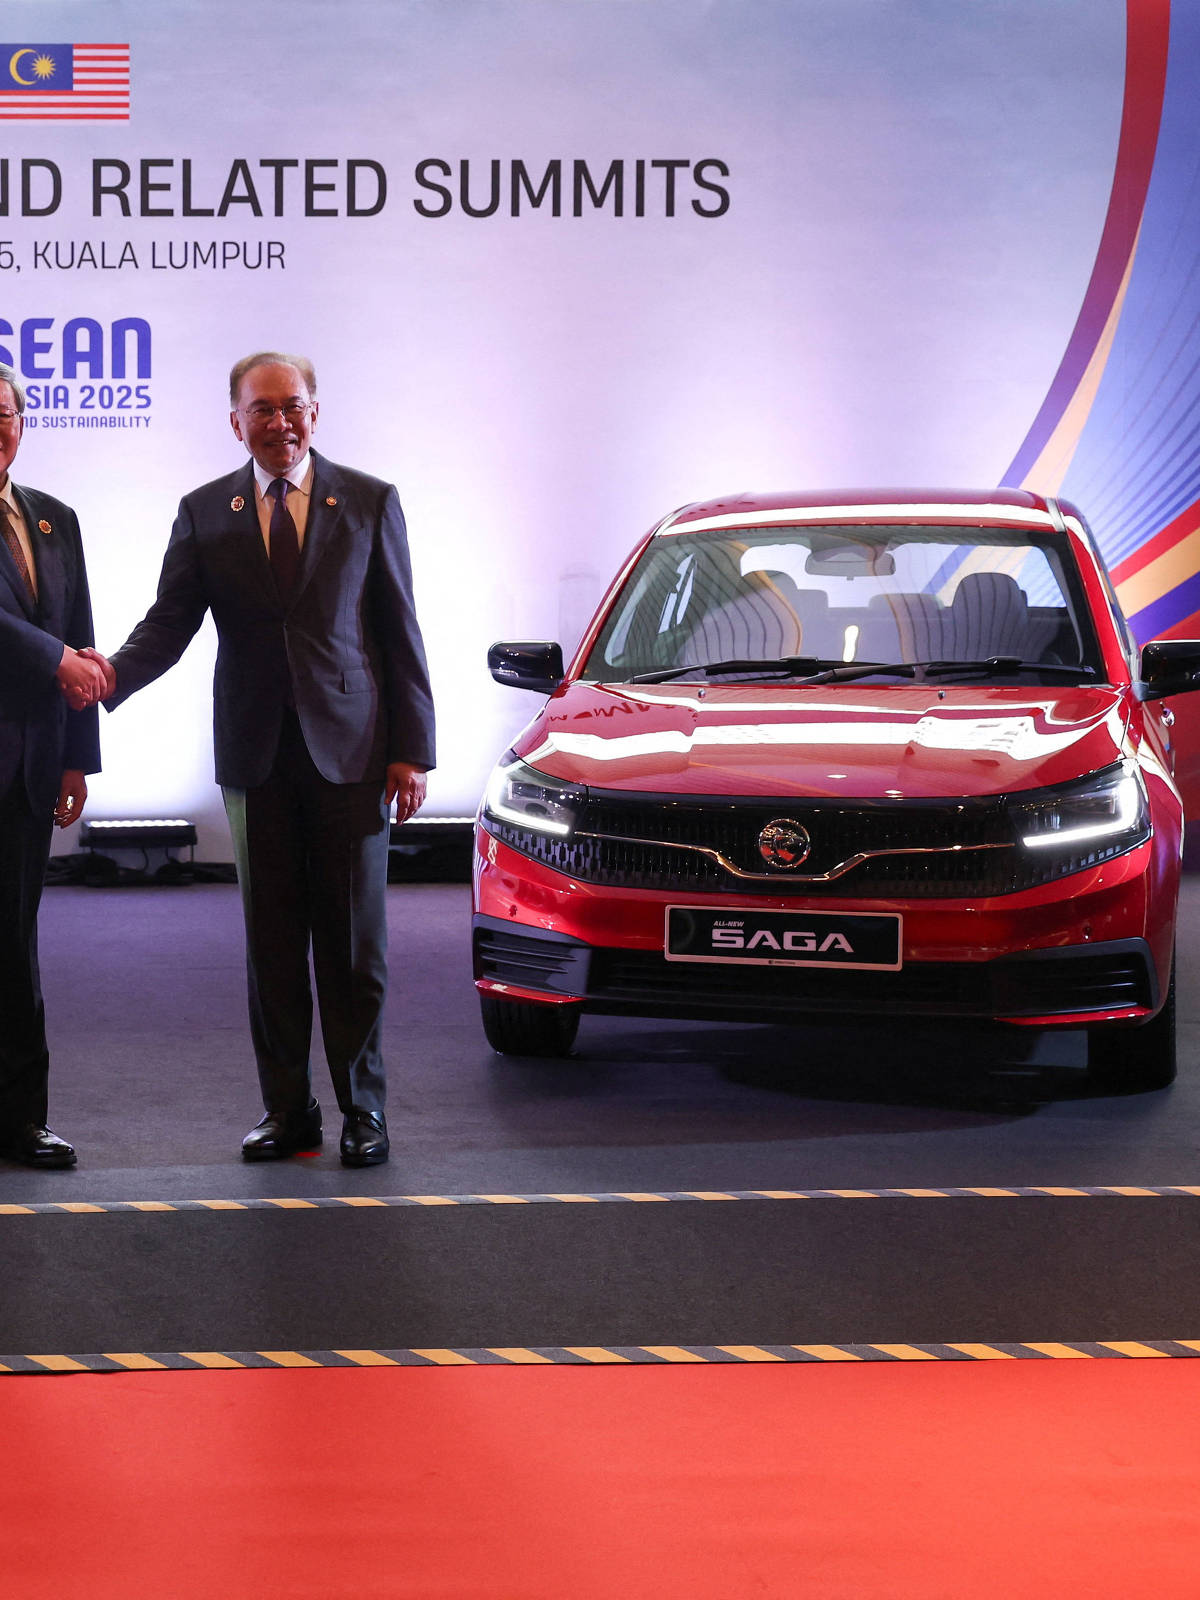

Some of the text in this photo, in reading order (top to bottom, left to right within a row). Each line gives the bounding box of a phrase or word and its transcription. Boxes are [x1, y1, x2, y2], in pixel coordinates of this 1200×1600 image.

[92, 158, 387, 217] RELATED
[413, 158, 731, 219] SUMMITS
[33, 240, 139, 270] KUALA
[151, 240, 286, 270] LUMPUR
[79, 385, 152, 410] 2025
[41, 415, 151, 429] SUSTAINABILITY
[713, 920, 745, 928] ALL-NEW
[711, 928, 855, 954] SAGA
